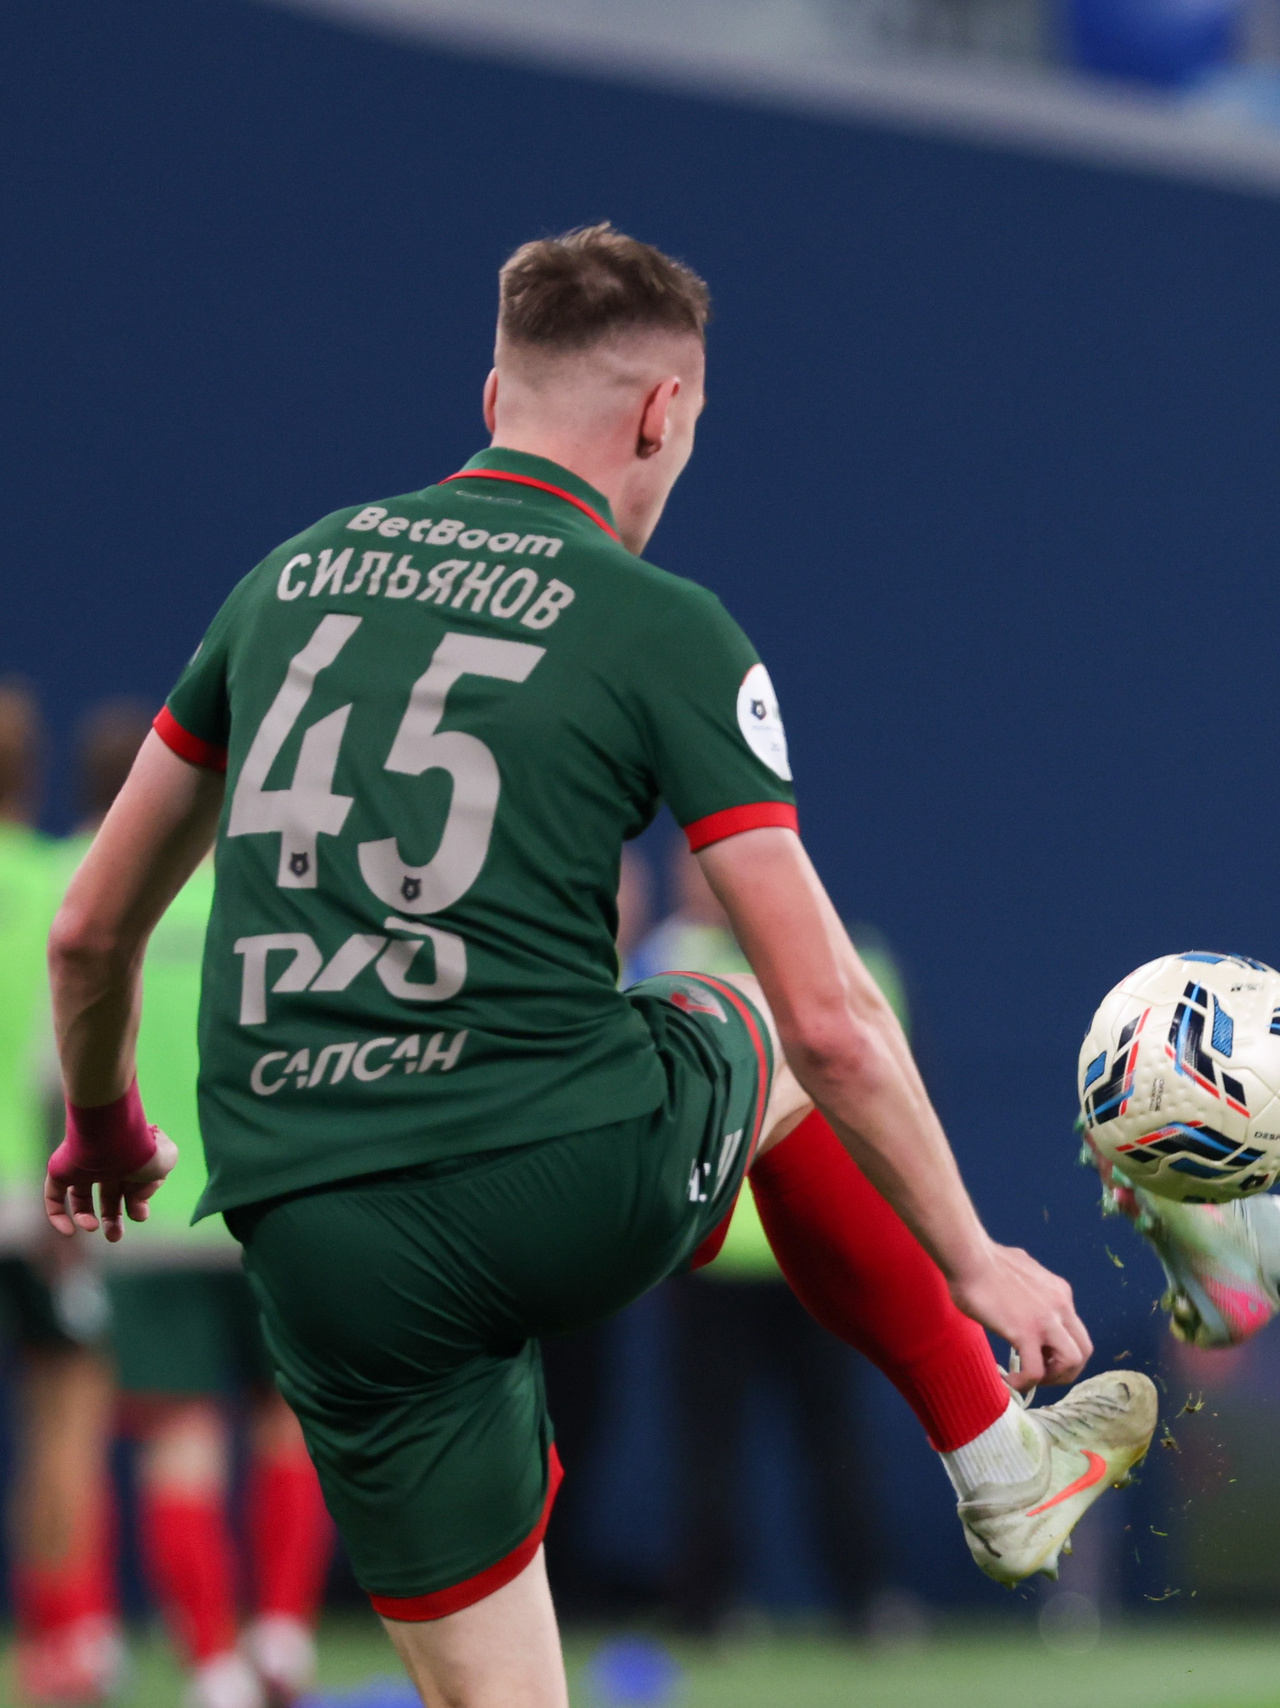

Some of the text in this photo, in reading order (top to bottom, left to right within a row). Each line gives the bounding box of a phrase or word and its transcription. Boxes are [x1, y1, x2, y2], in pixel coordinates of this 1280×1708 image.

[346, 506, 564, 558] BetBoom
[276, 546, 576, 631] СИЛЬЯНОВ
[227, 613, 547, 915] 45
[250, 1029, 468, 1096] САПСАН
